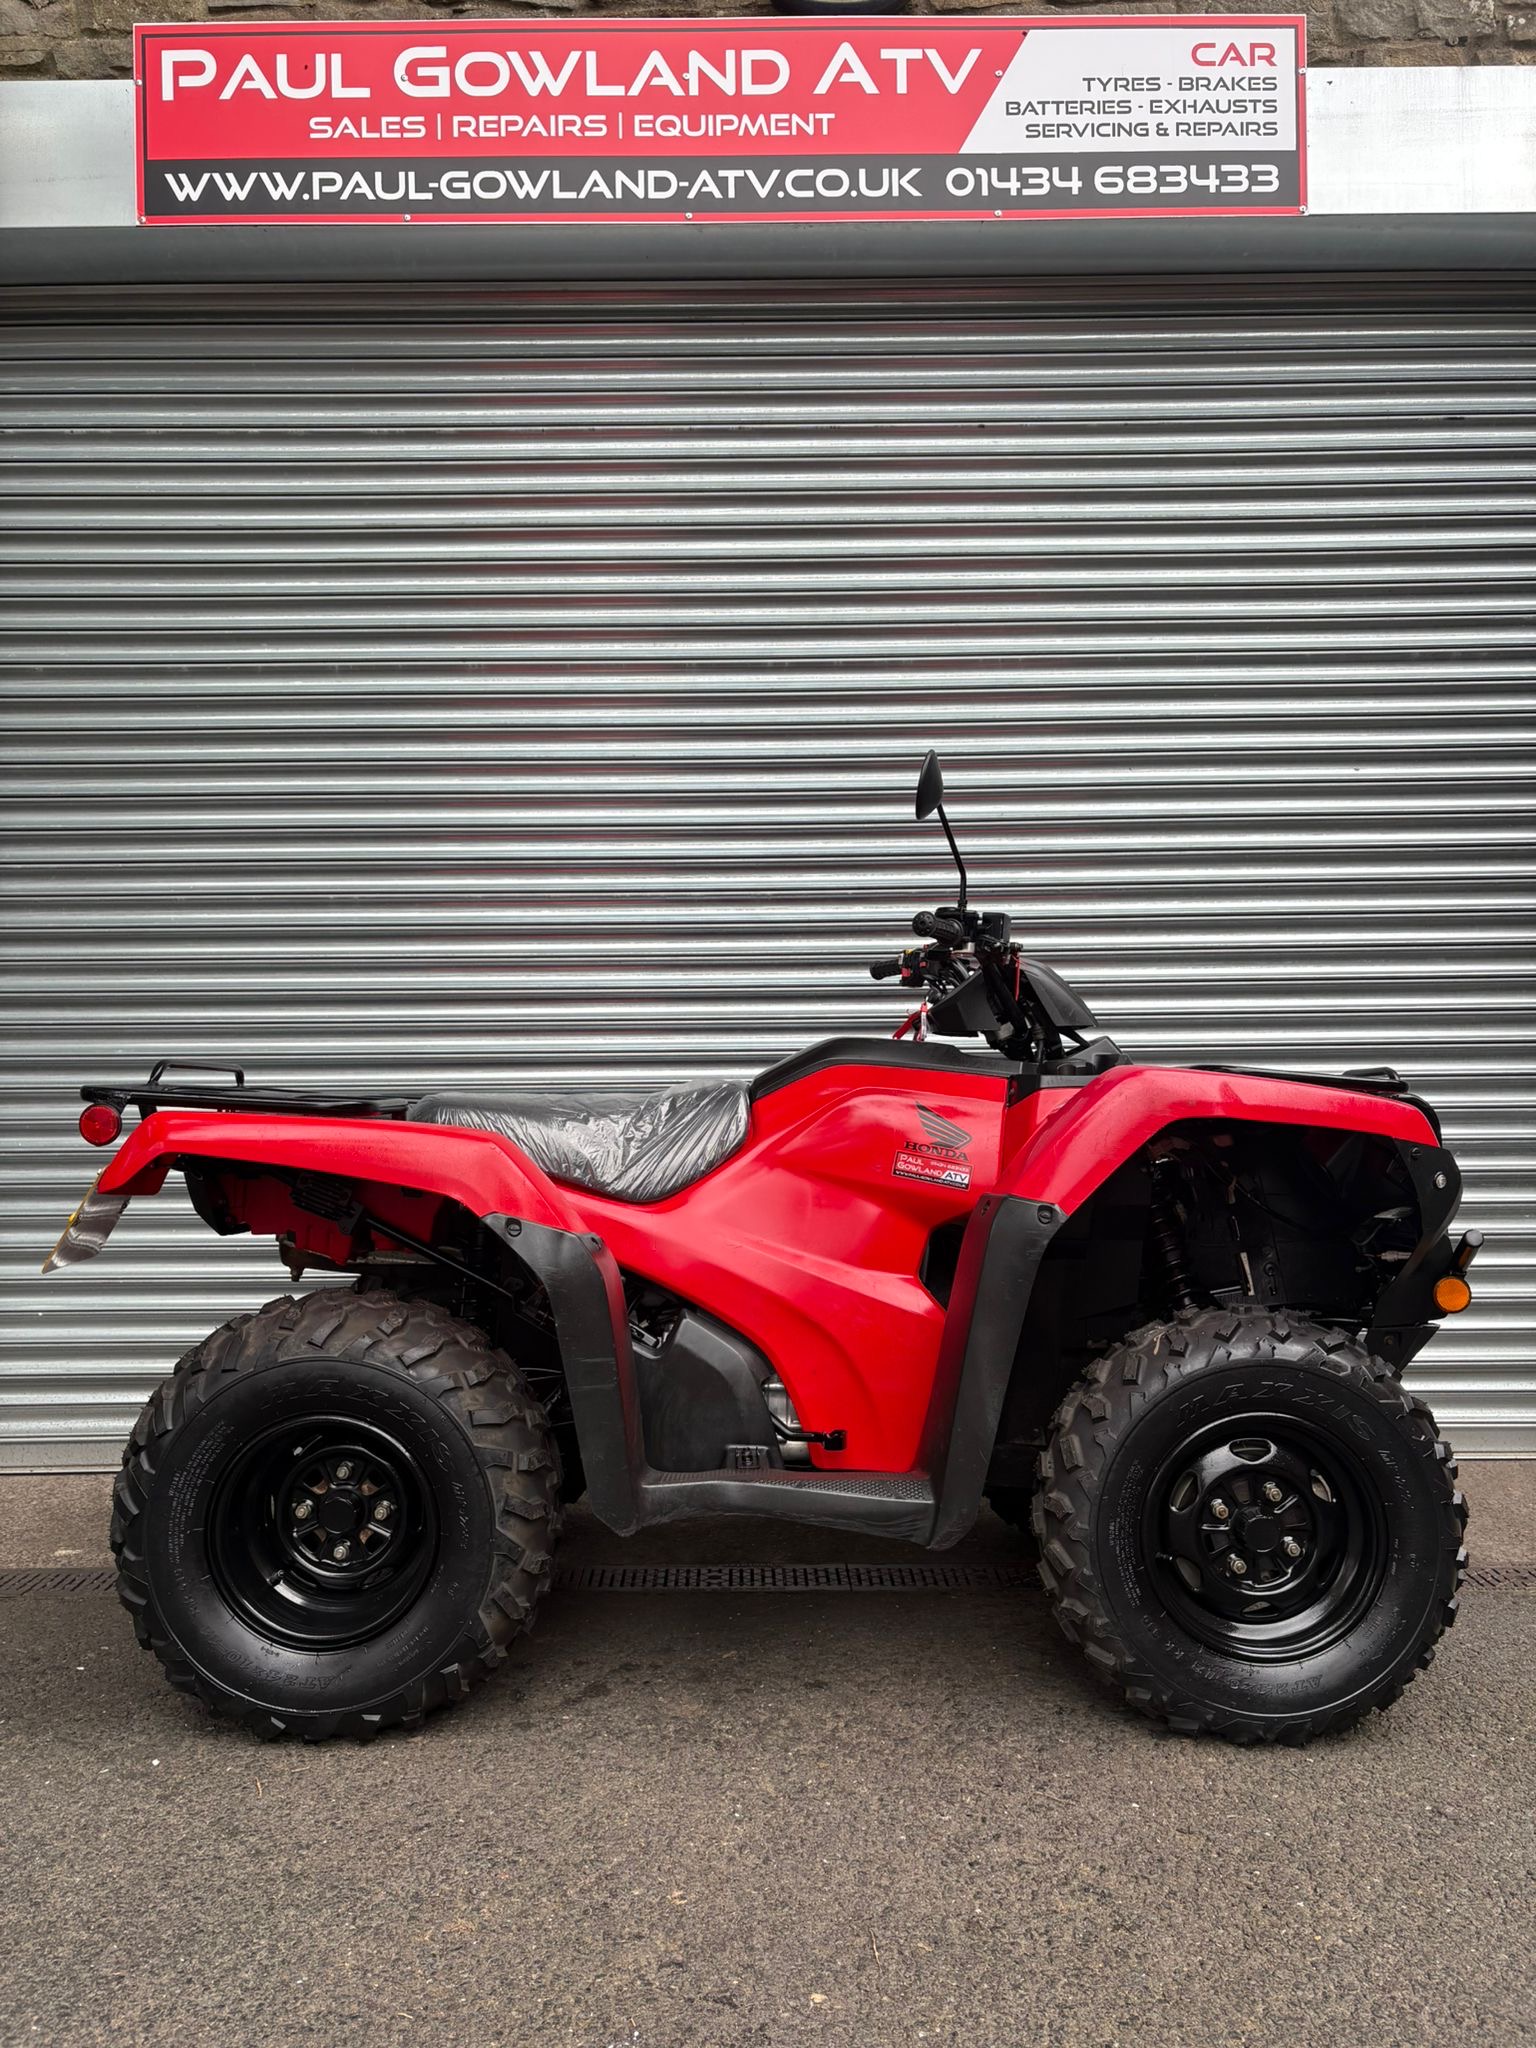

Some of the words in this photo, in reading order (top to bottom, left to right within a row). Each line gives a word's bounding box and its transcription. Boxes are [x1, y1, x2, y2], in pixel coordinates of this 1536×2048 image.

[1191, 42, 1277, 67] CAR
[161, 49, 371, 102] PAUL
[393, 45, 791, 98] GOWLAND
[812, 41, 982, 95] ATV
[1082, 76, 1162, 92] TYRES
[1178, 76, 1278, 92] BRAKES
[1005, 99, 1132, 116] BATTERIES
[1149, 99, 1278, 115] EXHAUSTS
[309, 115, 427, 139] SALES
[452, 114, 608, 138] REPAIRS
[634, 113, 836, 137] EQUIPMENT
[1025, 122, 1150, 139] SERVICING
[1155, 122, 1170, 137] &
[1175, 121, 1279, 137] REPAIRS
[164, 167, 923, 202] WWW.PAUL-GOWLAND-ATV.CO.UK
[945, 166, 1083, 197] 01434
[1093, 164, 1280, 195] 683433
[900, 1154, 924, 1165] PAUL
[905, 1141, 968, 1161] HONDA
[897, 1161, 942, 1177] GOWLAND
[945, 1172, 968, 1182] ATV
